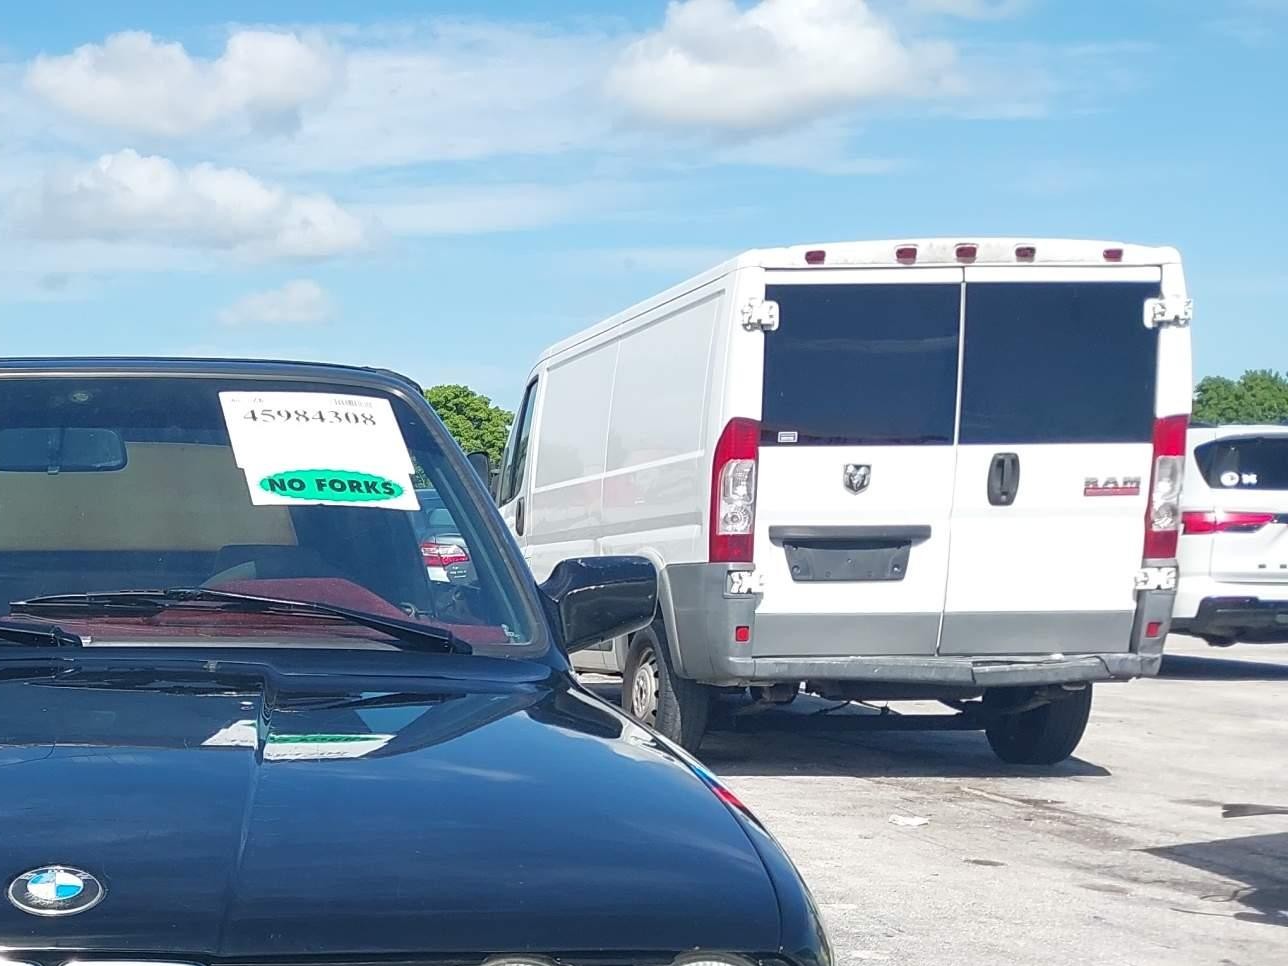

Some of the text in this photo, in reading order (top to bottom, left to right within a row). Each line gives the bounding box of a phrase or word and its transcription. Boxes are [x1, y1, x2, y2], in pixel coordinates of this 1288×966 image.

[243, 408, 377, 426] 45984308
[267, 477, 395, 496] NO FORKS
[1084, 476, 1141, 488] RAM
